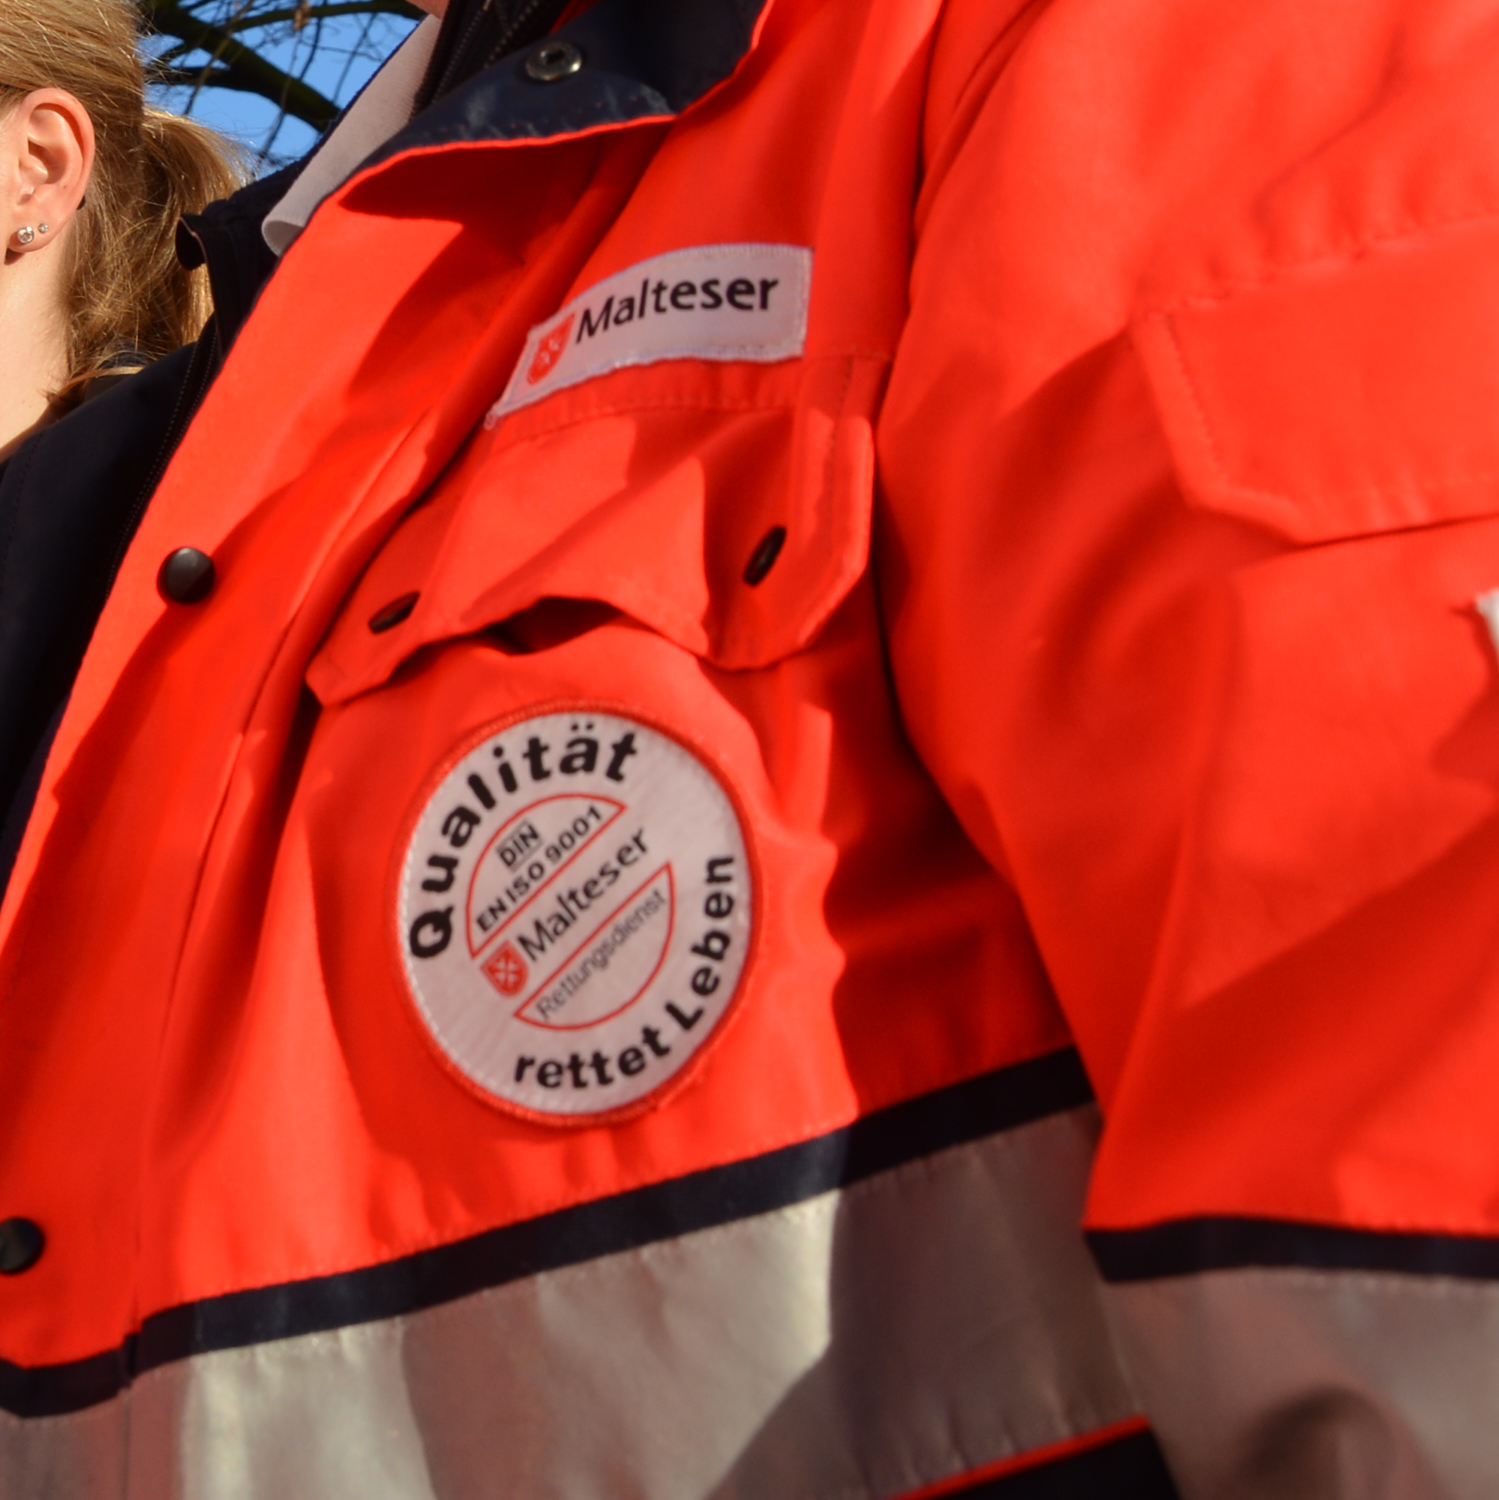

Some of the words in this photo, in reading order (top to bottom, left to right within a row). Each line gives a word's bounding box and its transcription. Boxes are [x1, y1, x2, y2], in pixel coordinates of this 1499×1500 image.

[575, 277, 779, 344] Malteser
[408, 723, 638, 959] Qualität
[476, 896, 507, 932] EN
[505, 862, 546, 904] ISO
[544, 804, 603, 865] 9001
[499, 823, 539, 867] DIN
[518, 827, 649, 962] Malteser
[514, 1025, 671, 1090] rettet
[664, 855, 736, 1032] Leben
[536, 888, 668, 1022] Rettungsdienst
